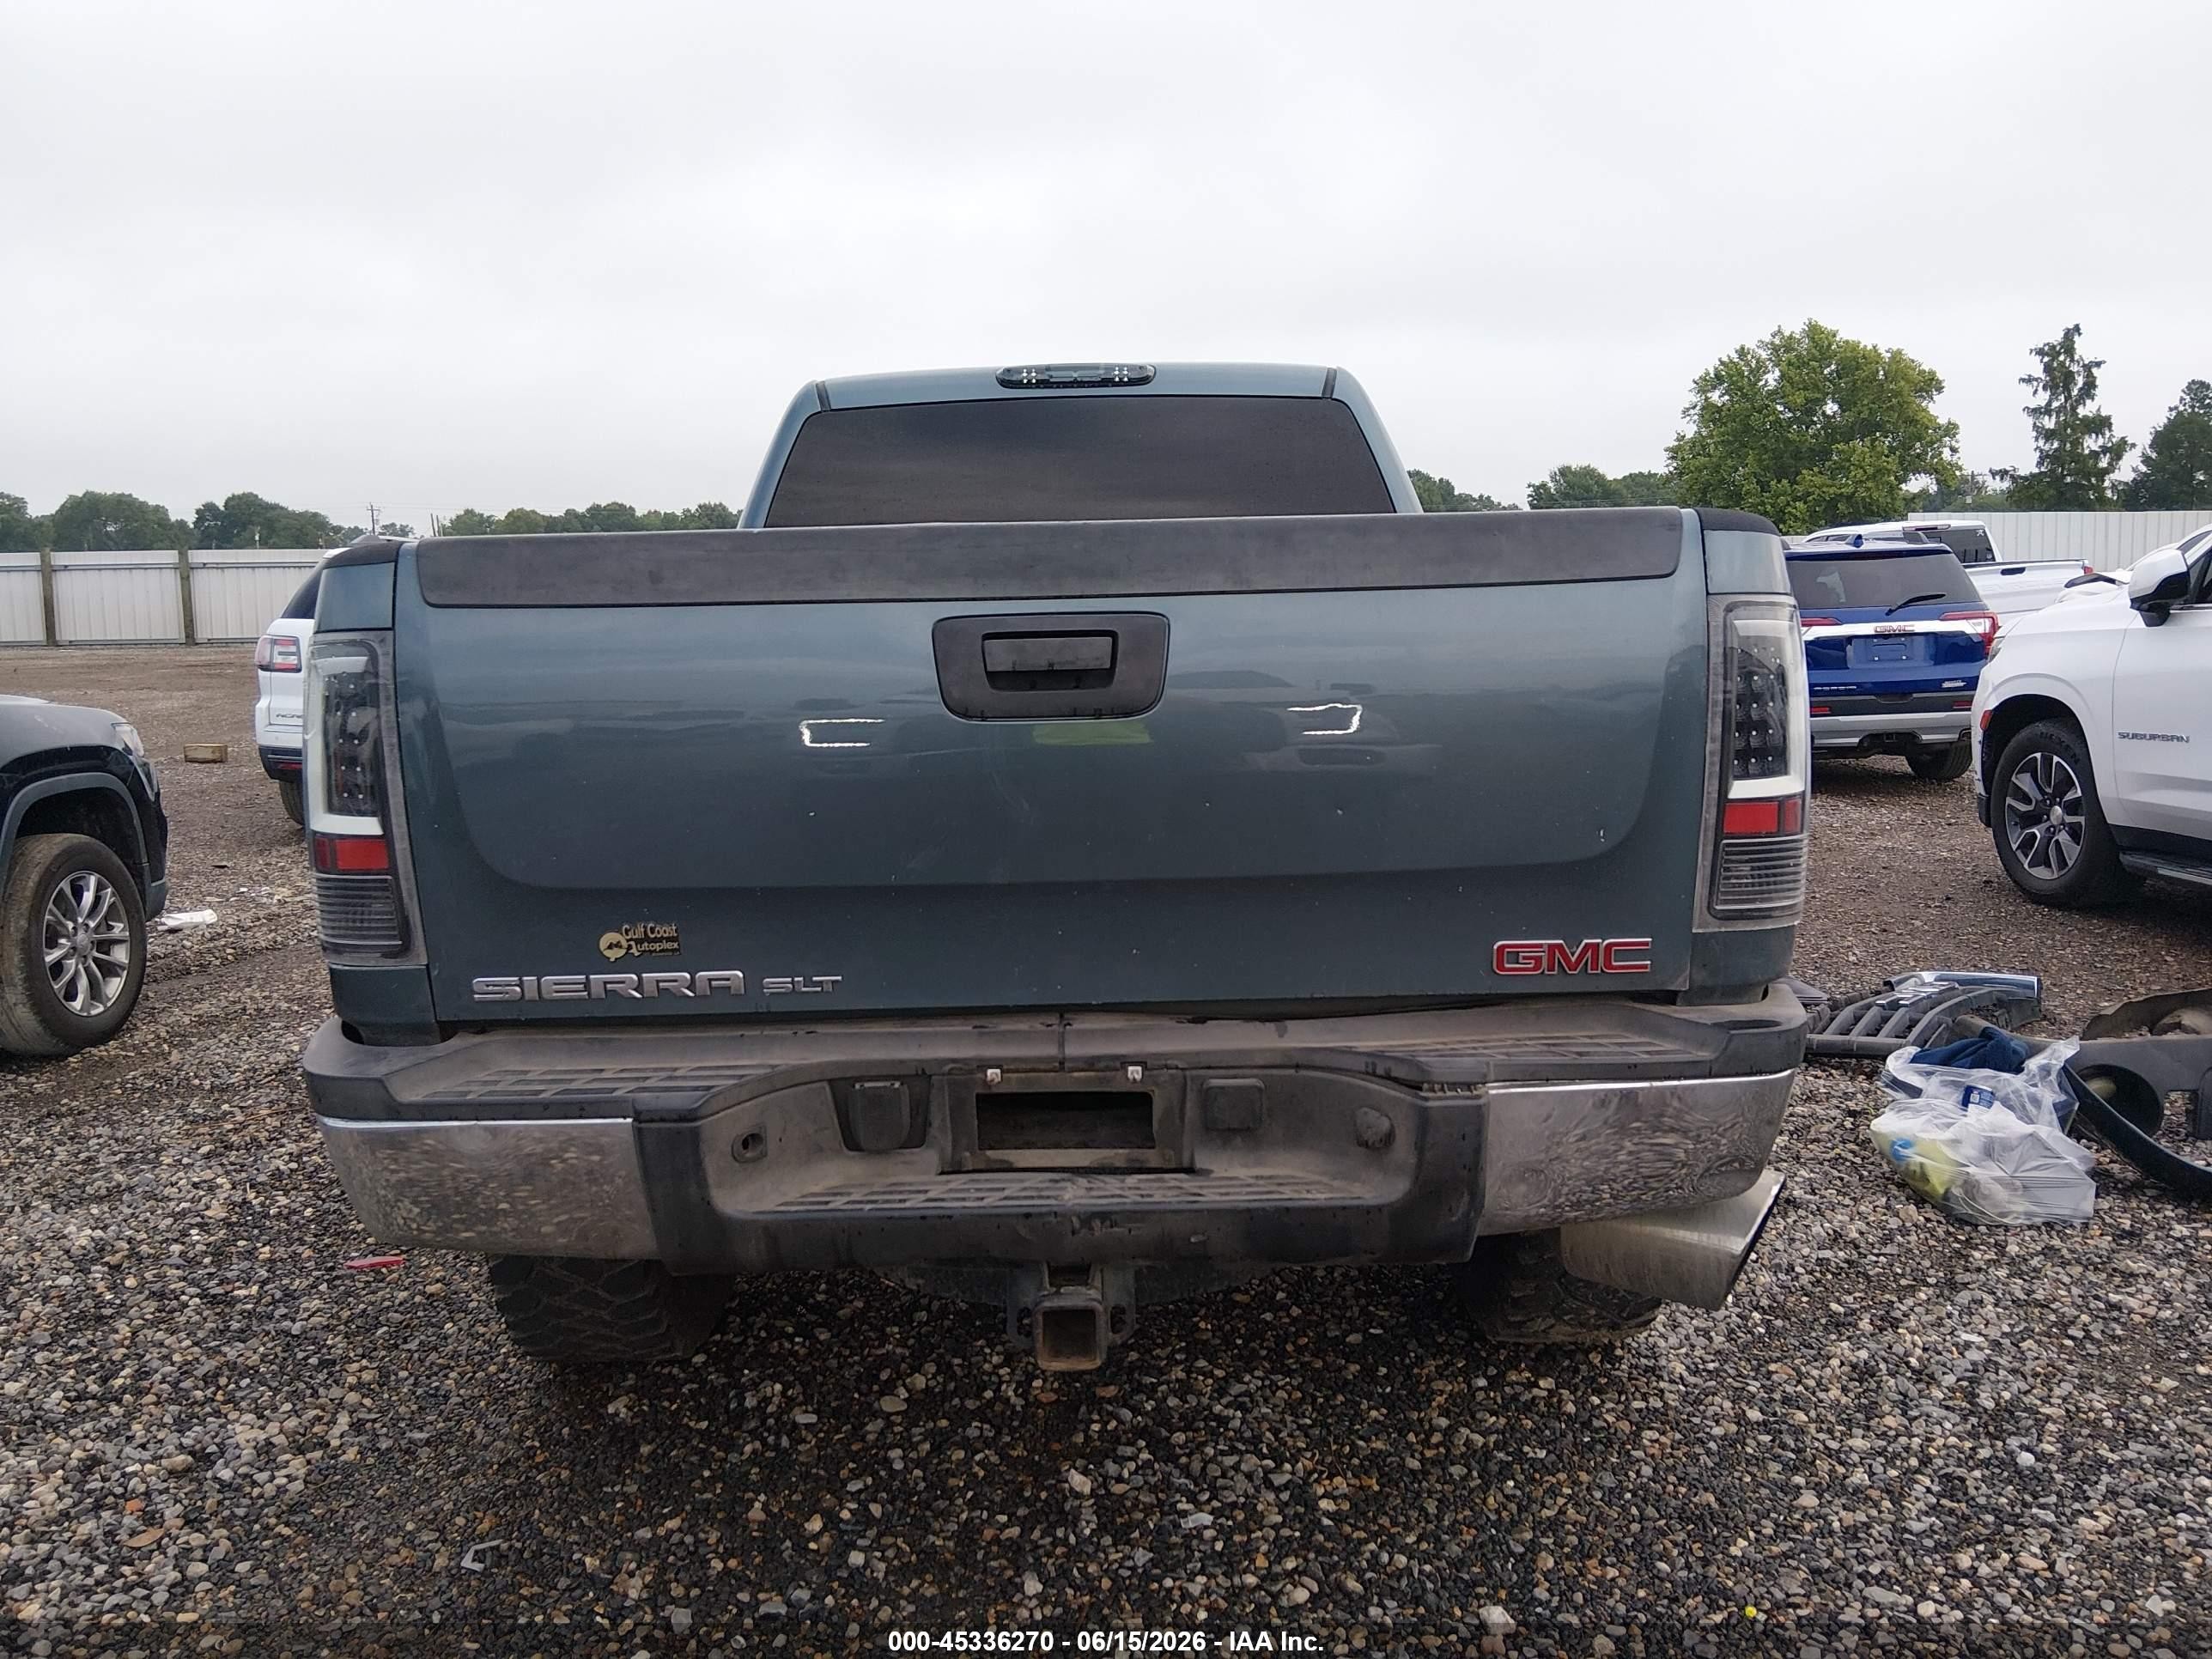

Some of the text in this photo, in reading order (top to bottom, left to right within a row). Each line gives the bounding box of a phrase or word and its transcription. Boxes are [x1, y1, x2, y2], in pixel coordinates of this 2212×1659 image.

[1874, 624, 1916, 634] GMC
[2118, 732, 2191, 744] SUBURBAN
[623, 923, 678, 939] Gulf Coast
[1492, 938, 1653, 975] GMC
[471, 970, 843, 1002] SIERRA SLT
